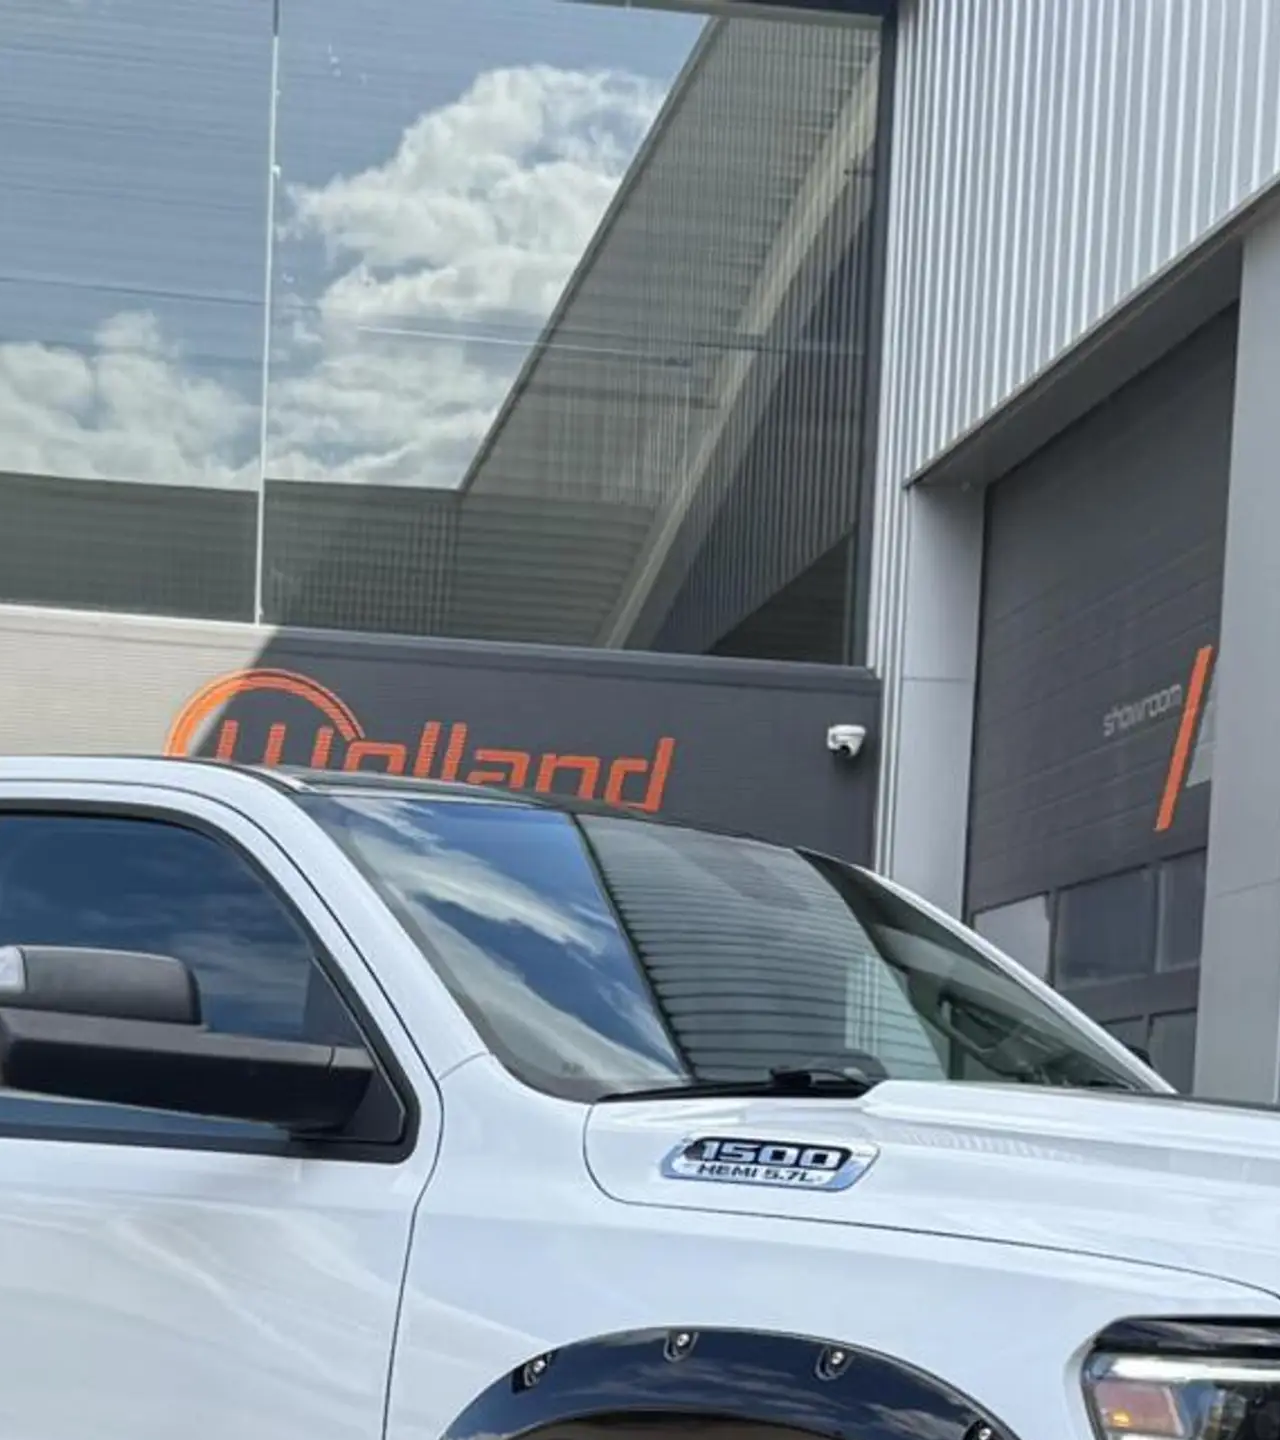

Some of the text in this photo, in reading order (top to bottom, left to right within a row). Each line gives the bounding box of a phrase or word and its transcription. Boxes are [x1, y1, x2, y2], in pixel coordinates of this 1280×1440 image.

[1103, 683, 1181, 737] showroom
[703, 1141, 841, 1169] 1500
[697, 1163, 816, 1183] HEMI 5.7L
